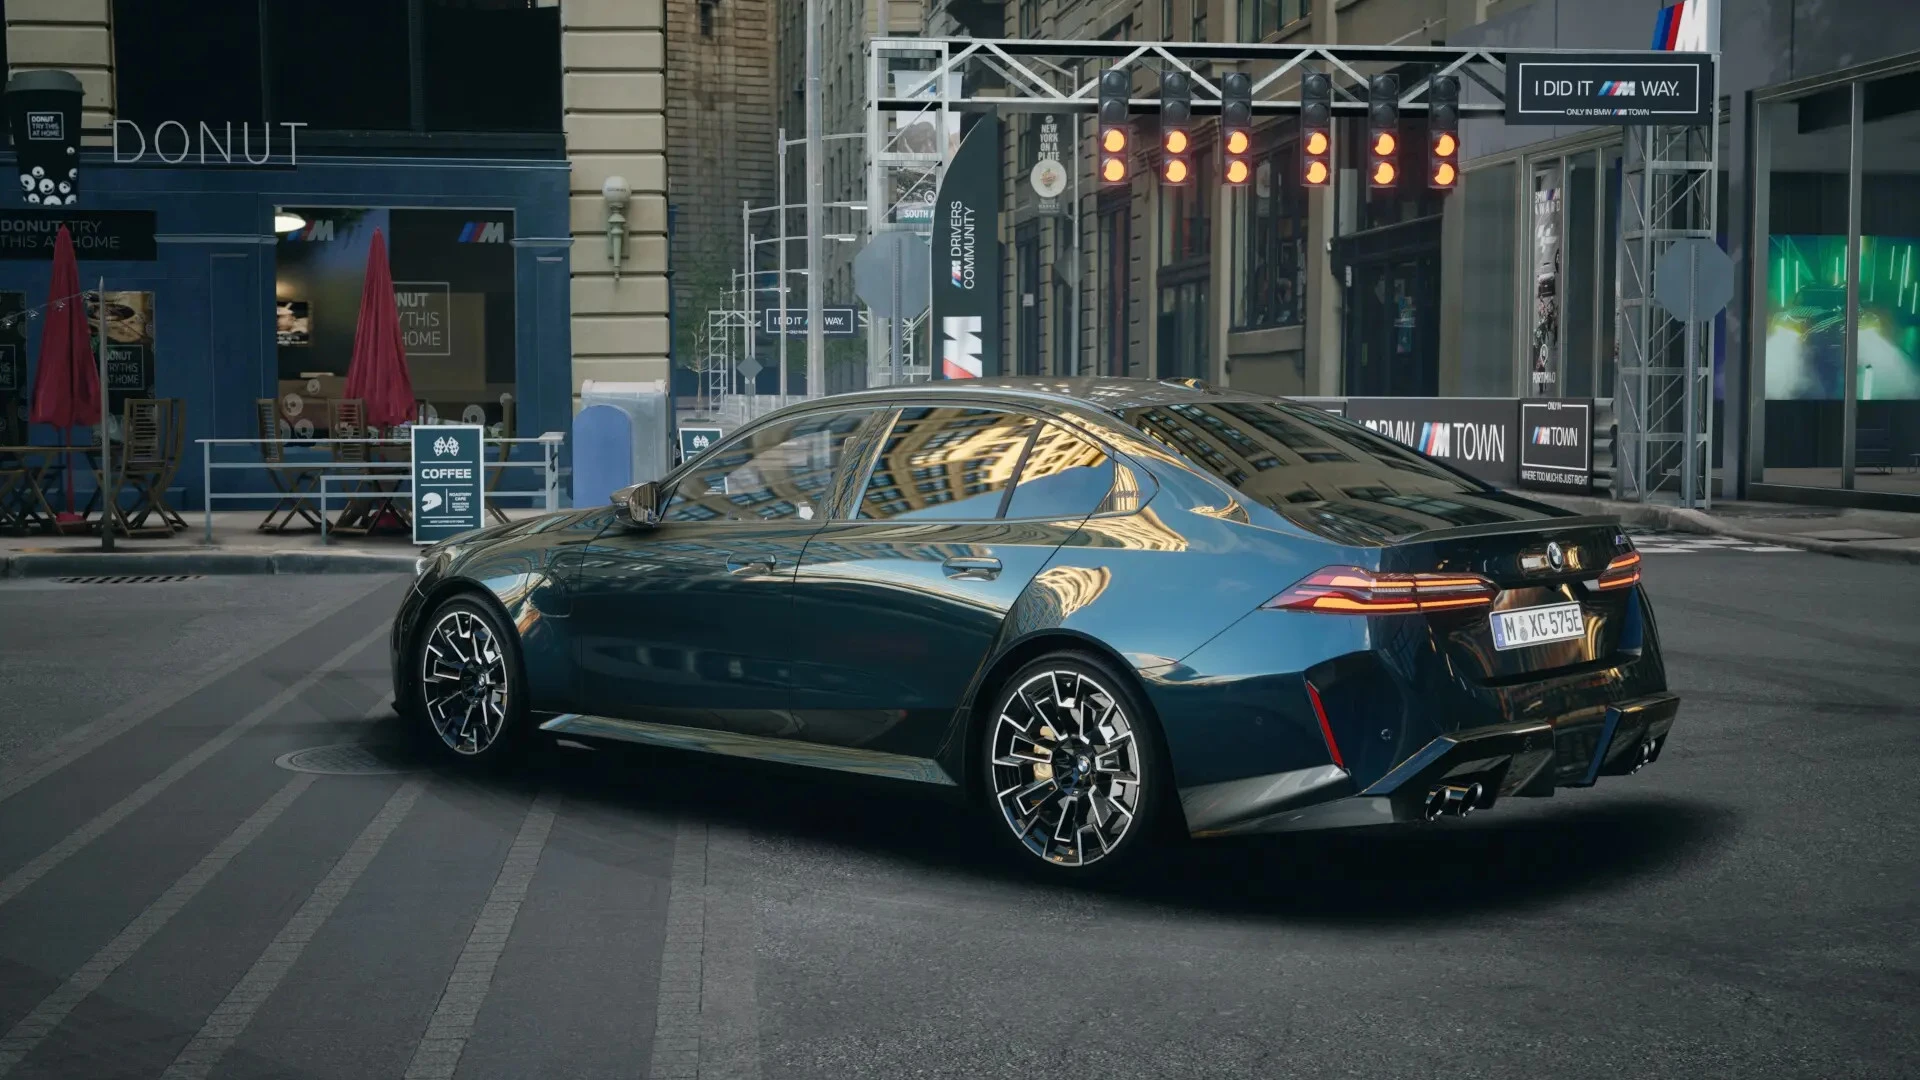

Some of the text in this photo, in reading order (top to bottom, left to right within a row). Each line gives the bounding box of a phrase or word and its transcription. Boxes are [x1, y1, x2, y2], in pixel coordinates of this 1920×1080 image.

[1535, 80, 1539, 96] I
[1544, 80, 1573, 96] DID
[1577, 80, 1594, 96] IT
[1641, 80, 1680, 97] WAY.
[1566, 108, 1584, 116] ONLY
[1585, 108, 1593, 116] IN
[1594, 108, 1612, 116] BMW
[1628, 108, 1650, 116] TOWN
[31, 115, 54, 123] DONUT
[32, 122, 59, 130] TRY THIS
[1041, 124, 1058, 133] NEW
[113, 119, 308, 166] DONUT
[1040, 133, 1059, 143] YORK
[1040, 143, 1058, 152] ON A
[1038, 152, 1060, 161] PLATE
[904, 209, 929, 218] SOUTH
[1, 220, 102, 233] DONUT TRY
[951, 200, 963, 257] DRIVERS
[0, 234, 37, 248] THIS
[963, 206, 976, 290] COMMUNITY
[394, 292, 429, 308] NUT
[405, 311, 440, 327] THIS
[794, 316, 803, 325] IT
[824, 316, 844, 326] WAY.
[120, 362, 138, 374] THIS
[115, 374, 139, 385] HOME
[1547, 401, 1562, 411] ONLY IN
[1453, 422, 1505, 463] TOWN
[1551, 426, 1578, 447] TOWN
[421, 468, 472, 479] COFFEE
[1522, 470, 1588, 486] WHERE TOO MUCH IS JUST RIGHT
[1504, 616, 1517, 641] M
[1528, 613, 1548, 638] XC
[1548, 608, 1582, 635] 575E
